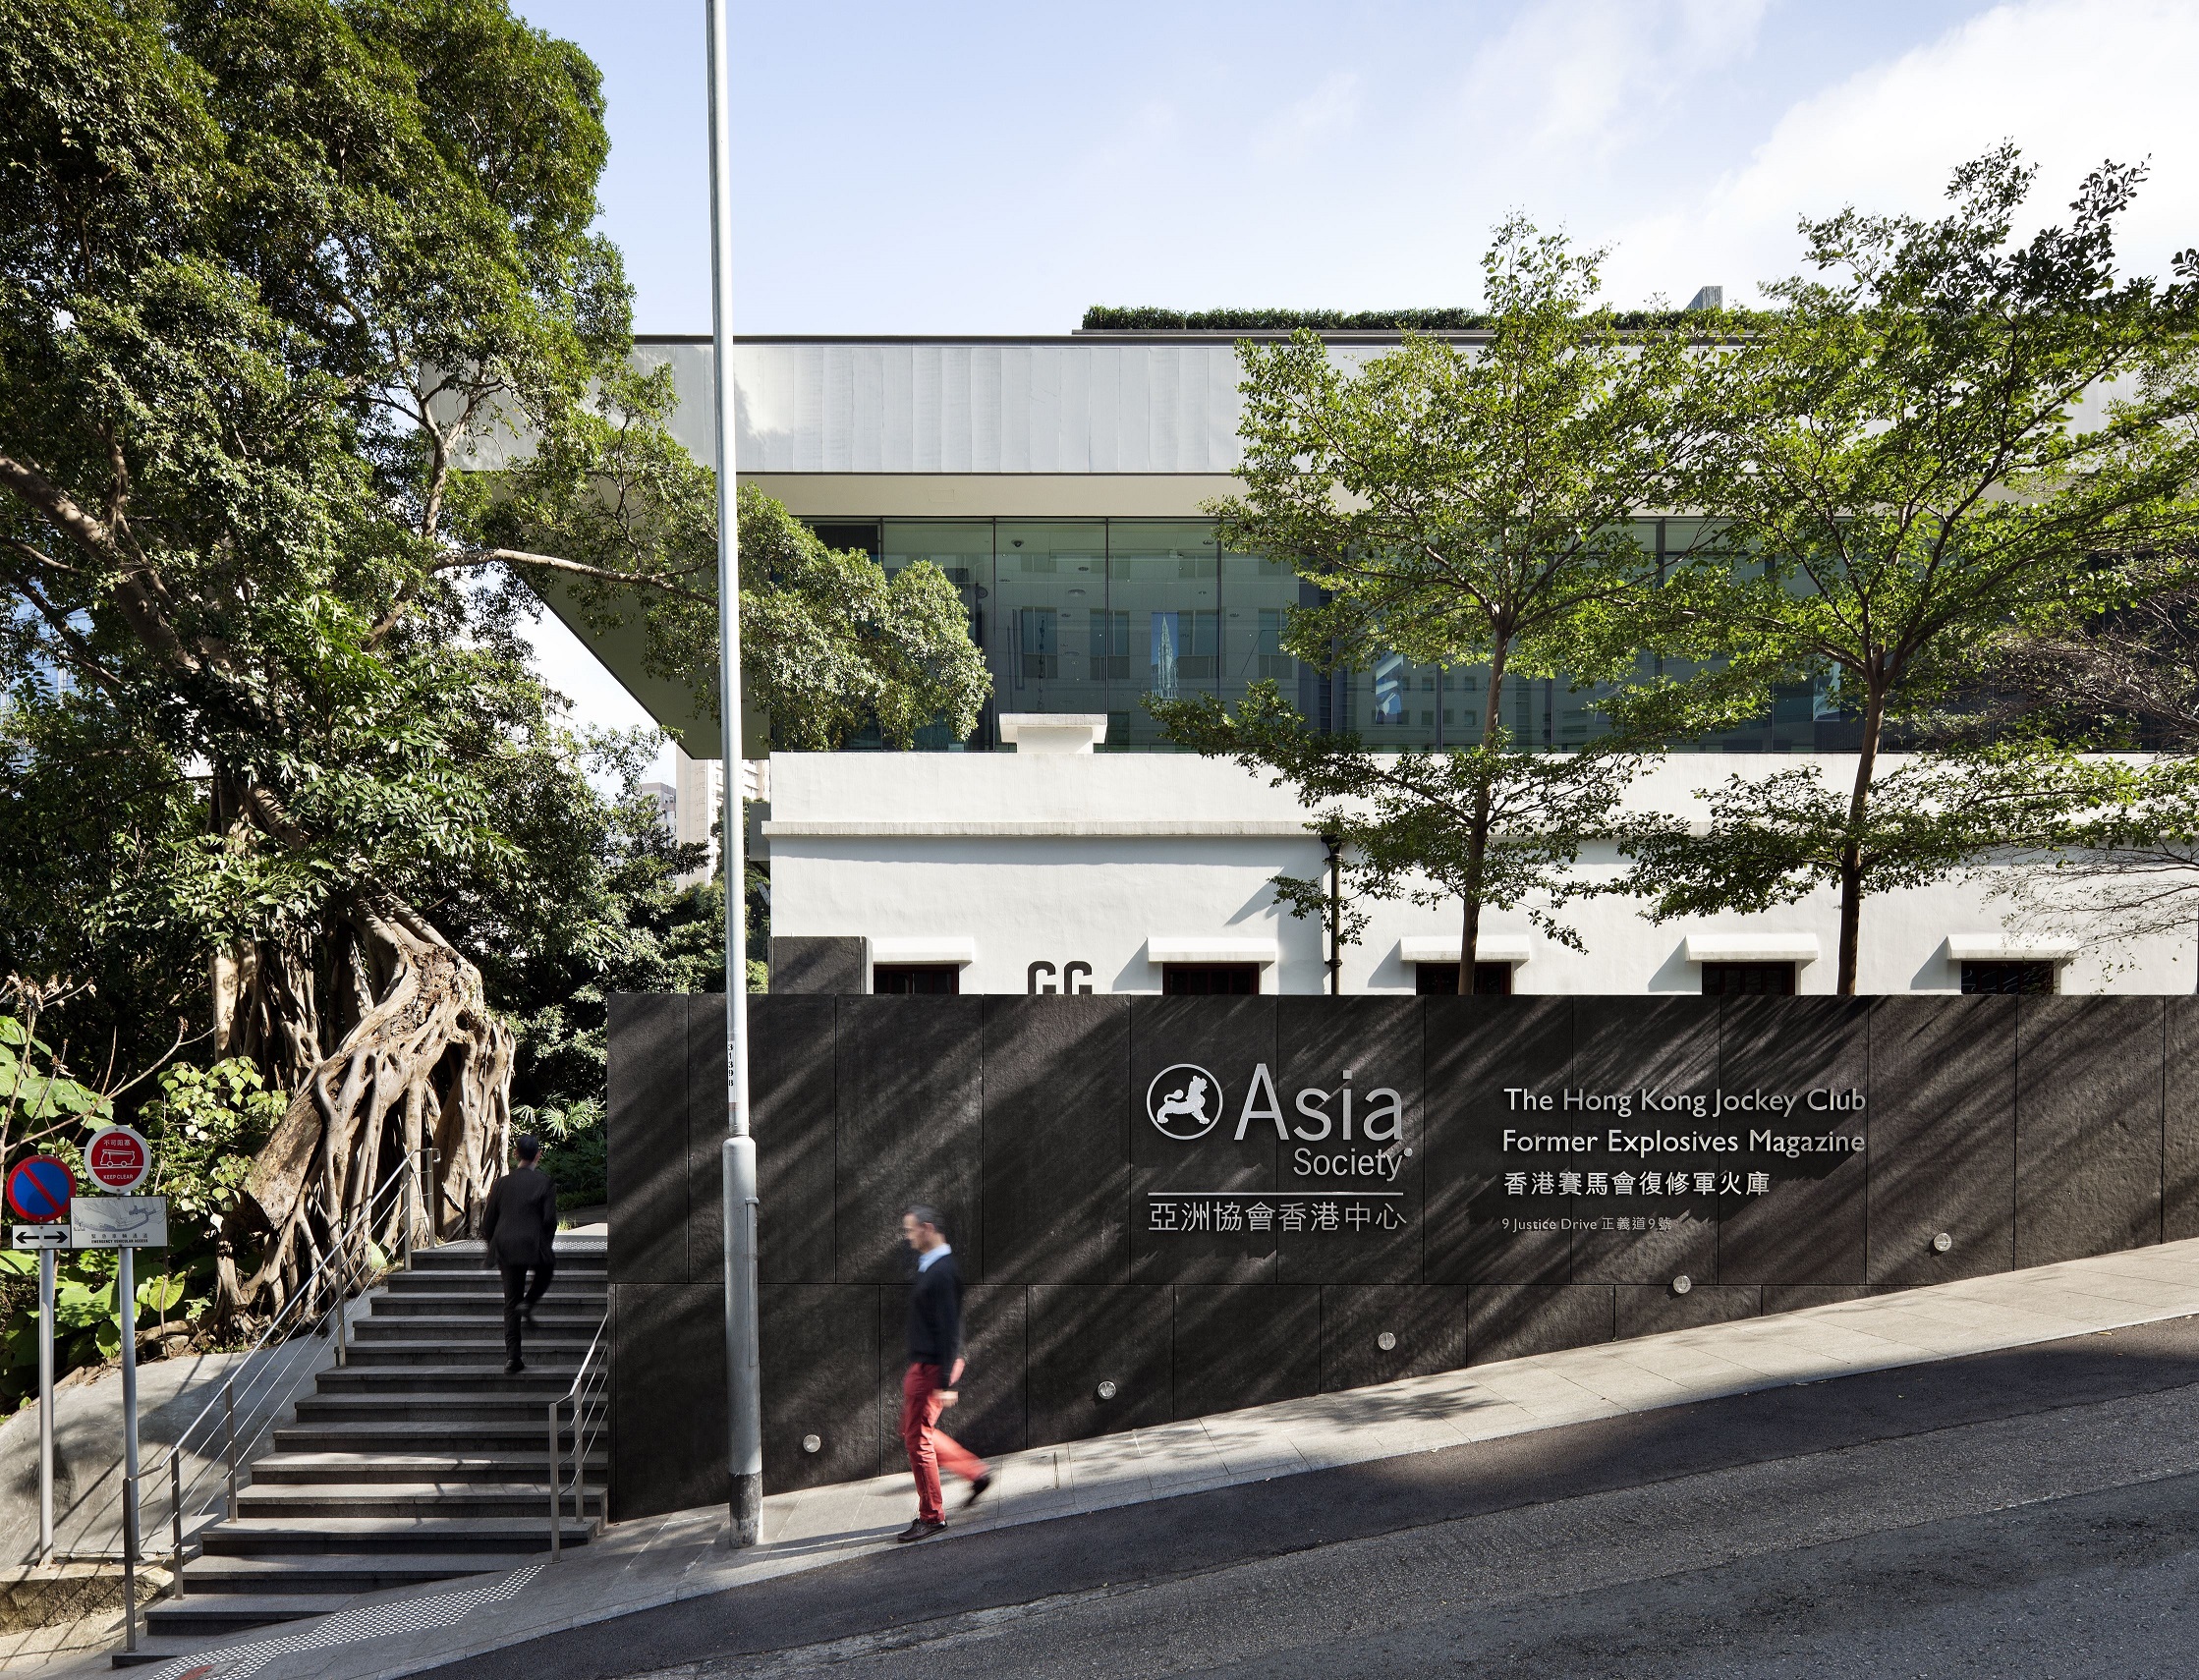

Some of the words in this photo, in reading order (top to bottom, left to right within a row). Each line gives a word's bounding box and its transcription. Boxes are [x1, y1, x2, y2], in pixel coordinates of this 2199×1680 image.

[1234, 1063, 1402, 1141] Asia
[1504, 1089, 1553, 1111] The
[1563, 1089, 1631, 1117] Hong
[1641, 1089, 1706, 1117] Kong
[1712, 1088, 1796, 1117] Jockey
[1807, 1088, 1866, 1111] Club
[1503, 1130, 1598, 1152] Former
[1608, 1130, 1738, 1158] Explosives
[1749, 1130, 1865, 1158] Magazine
[1293, 1148, 1403, 1182] Society
[1504, 1171, 1770, 1196] 香港賽馬會復修軍火庫
[1149, 1202, 1407, 1232] 亞洲協會香港中心
[1501, 1218, 1509, 1228] 9
[1513, 1218, 1556, 1233] Justice
[1560, 1218, 1598, 1230] Drive
